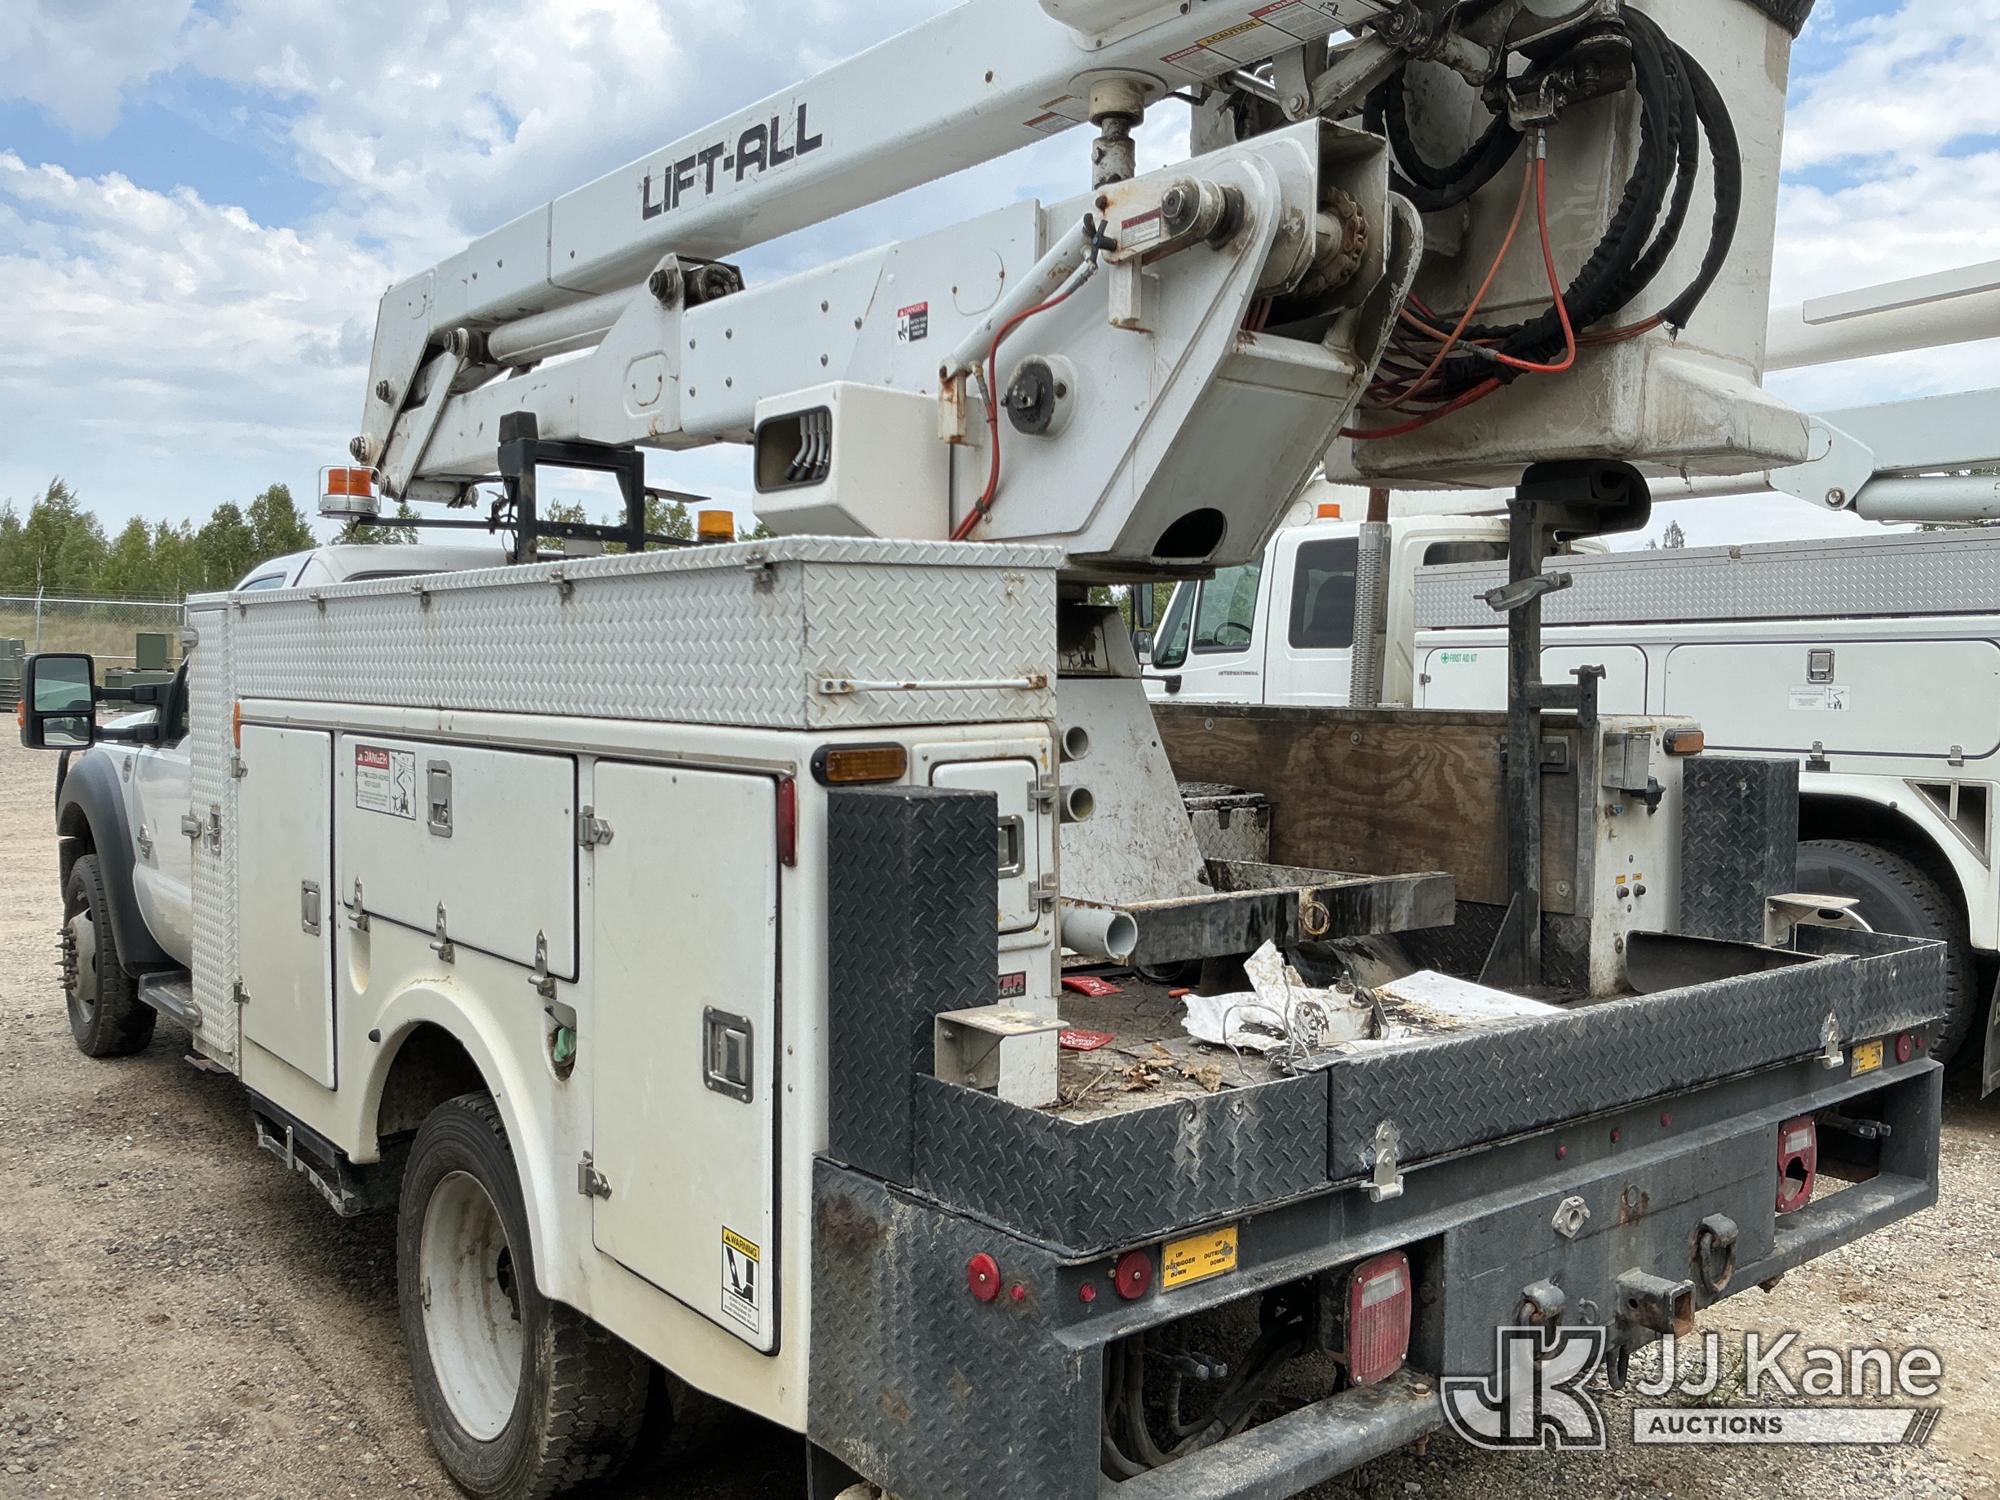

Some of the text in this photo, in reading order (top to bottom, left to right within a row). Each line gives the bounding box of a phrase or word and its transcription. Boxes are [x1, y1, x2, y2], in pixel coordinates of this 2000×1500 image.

[1211, 21, 1257, 41] CAUTION
[642, 102, 823, 221] LIFT-ALL
[364, 750, 388, 765] DANGER
[731, 1234, 757, 1258] WARNING
[1210, 1257, 1226, 1266] DOWN
